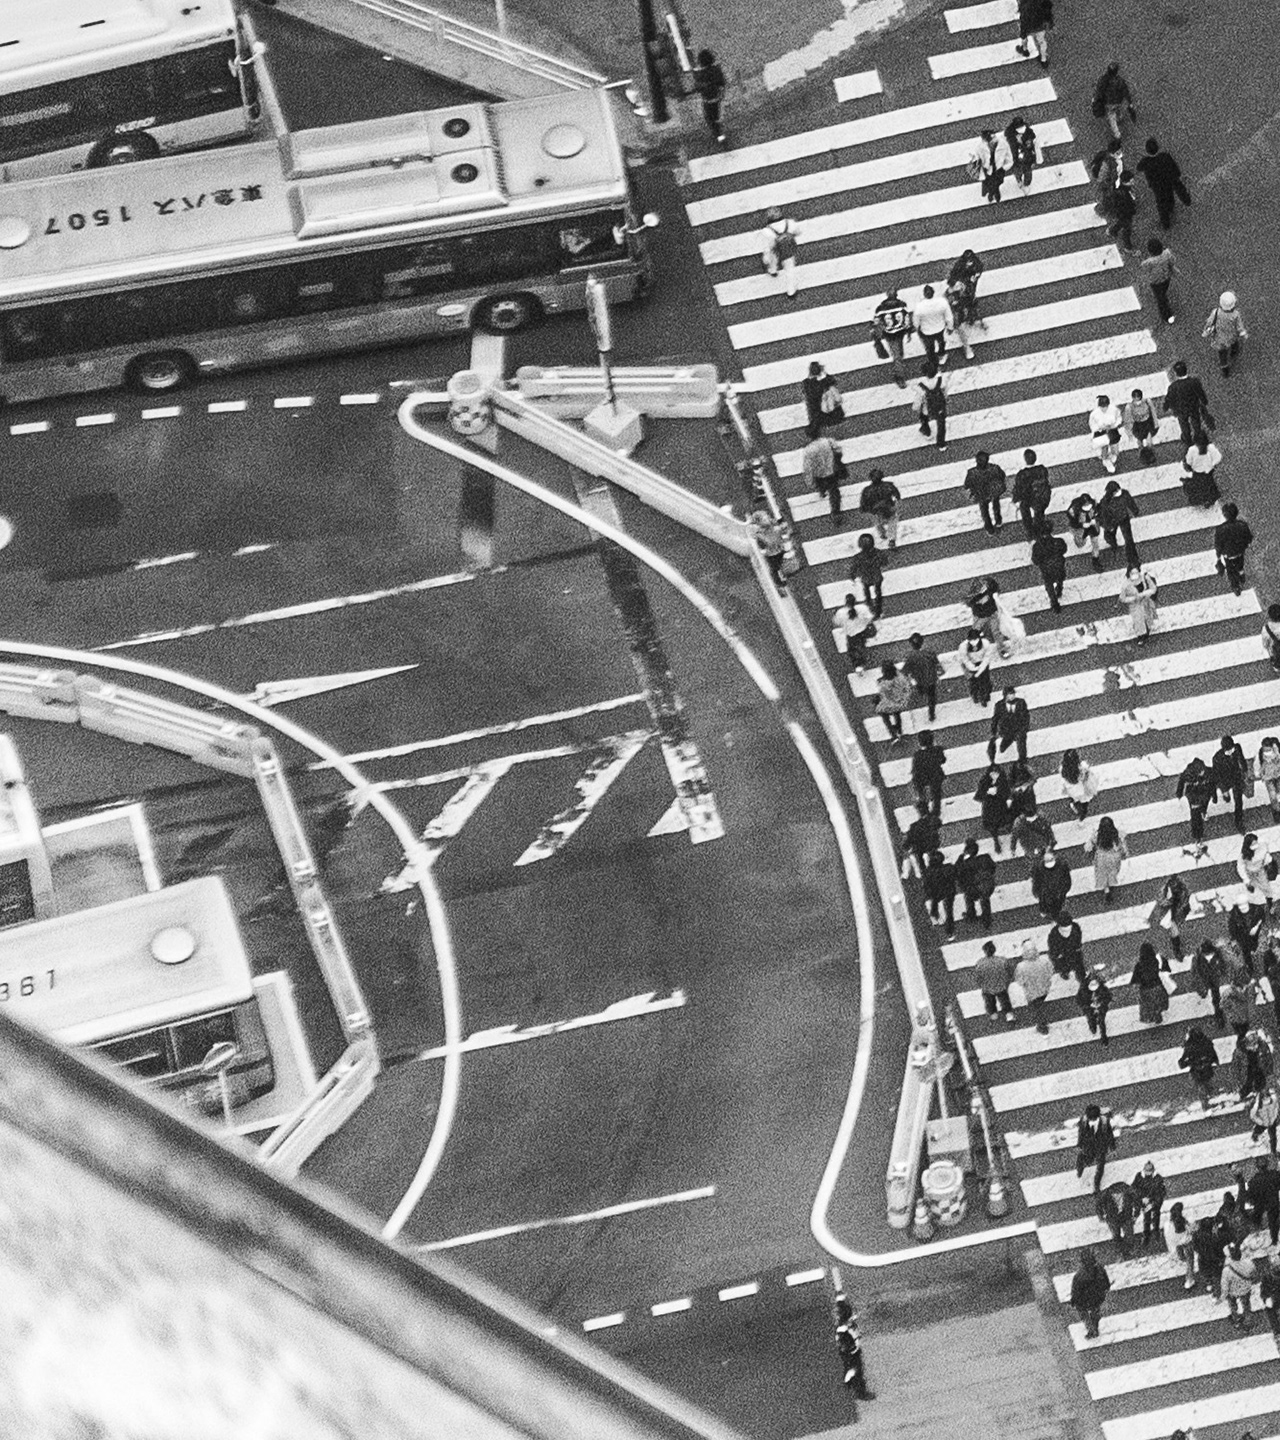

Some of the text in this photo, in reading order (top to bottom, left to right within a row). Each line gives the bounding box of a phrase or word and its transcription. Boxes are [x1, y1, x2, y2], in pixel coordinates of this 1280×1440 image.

[44, 182, 264, 236] 東急バス 1507
